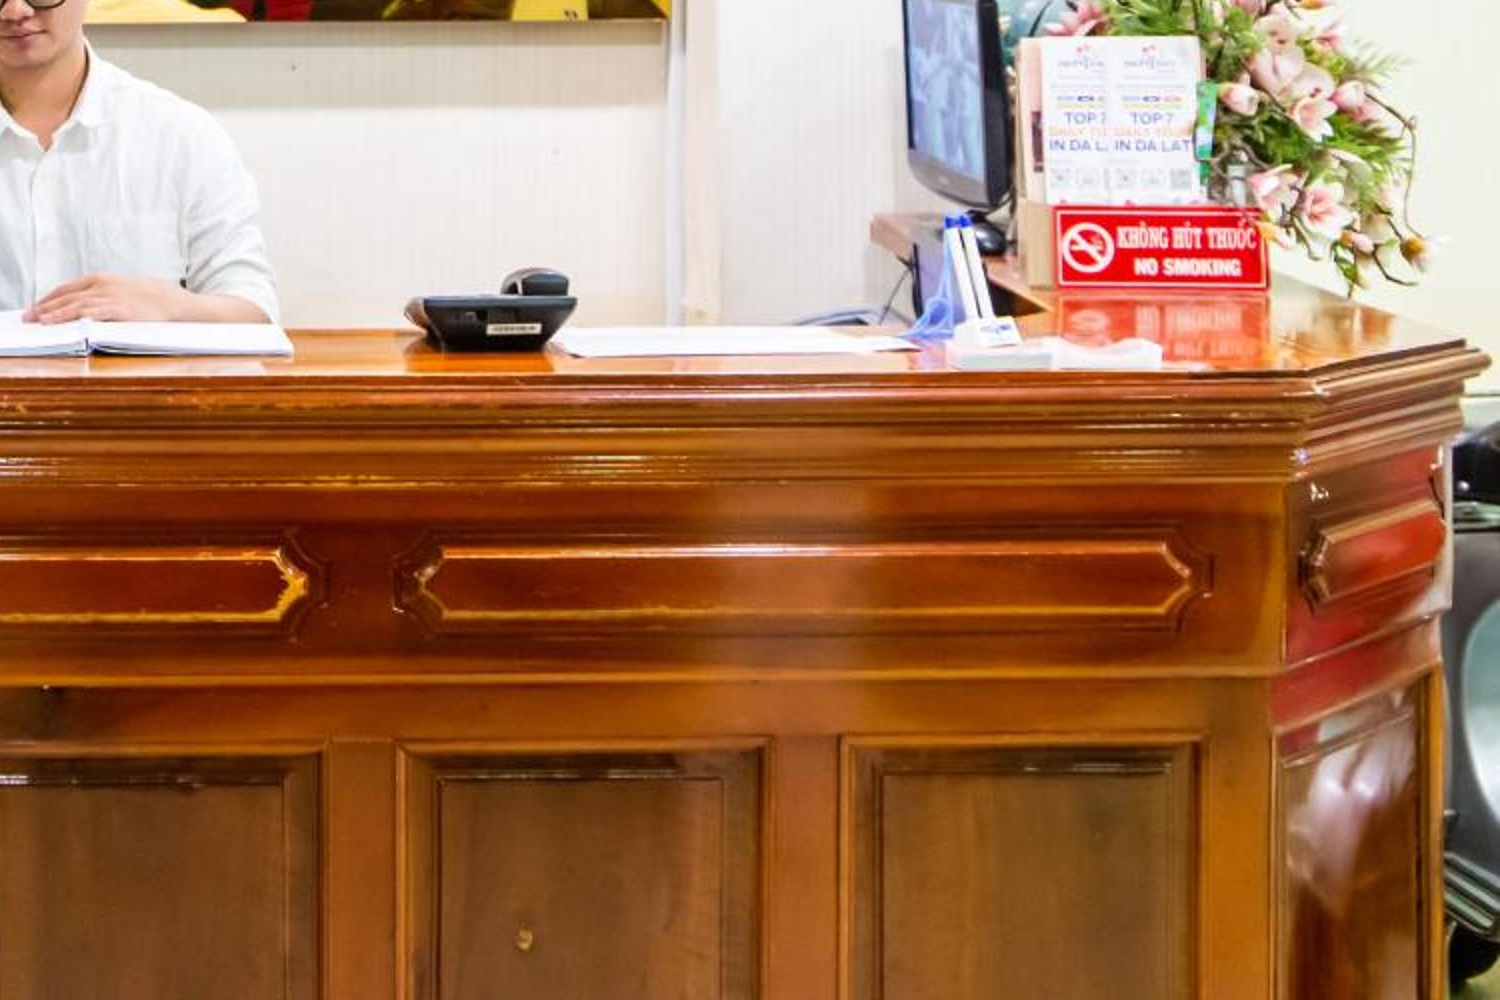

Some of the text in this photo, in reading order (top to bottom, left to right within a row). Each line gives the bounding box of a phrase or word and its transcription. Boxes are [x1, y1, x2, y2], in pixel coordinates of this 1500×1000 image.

[1064, 111, 1097, 125] TOP
[1130, 111, 1175, 125] TOP 7
[1049, 139, 1066, 151] IN
[1115, 139, 1131, 151] IN
[1171, 220, 1202, 249] HÚT
[1133, 257, 1243, 277] NO SMOKING
